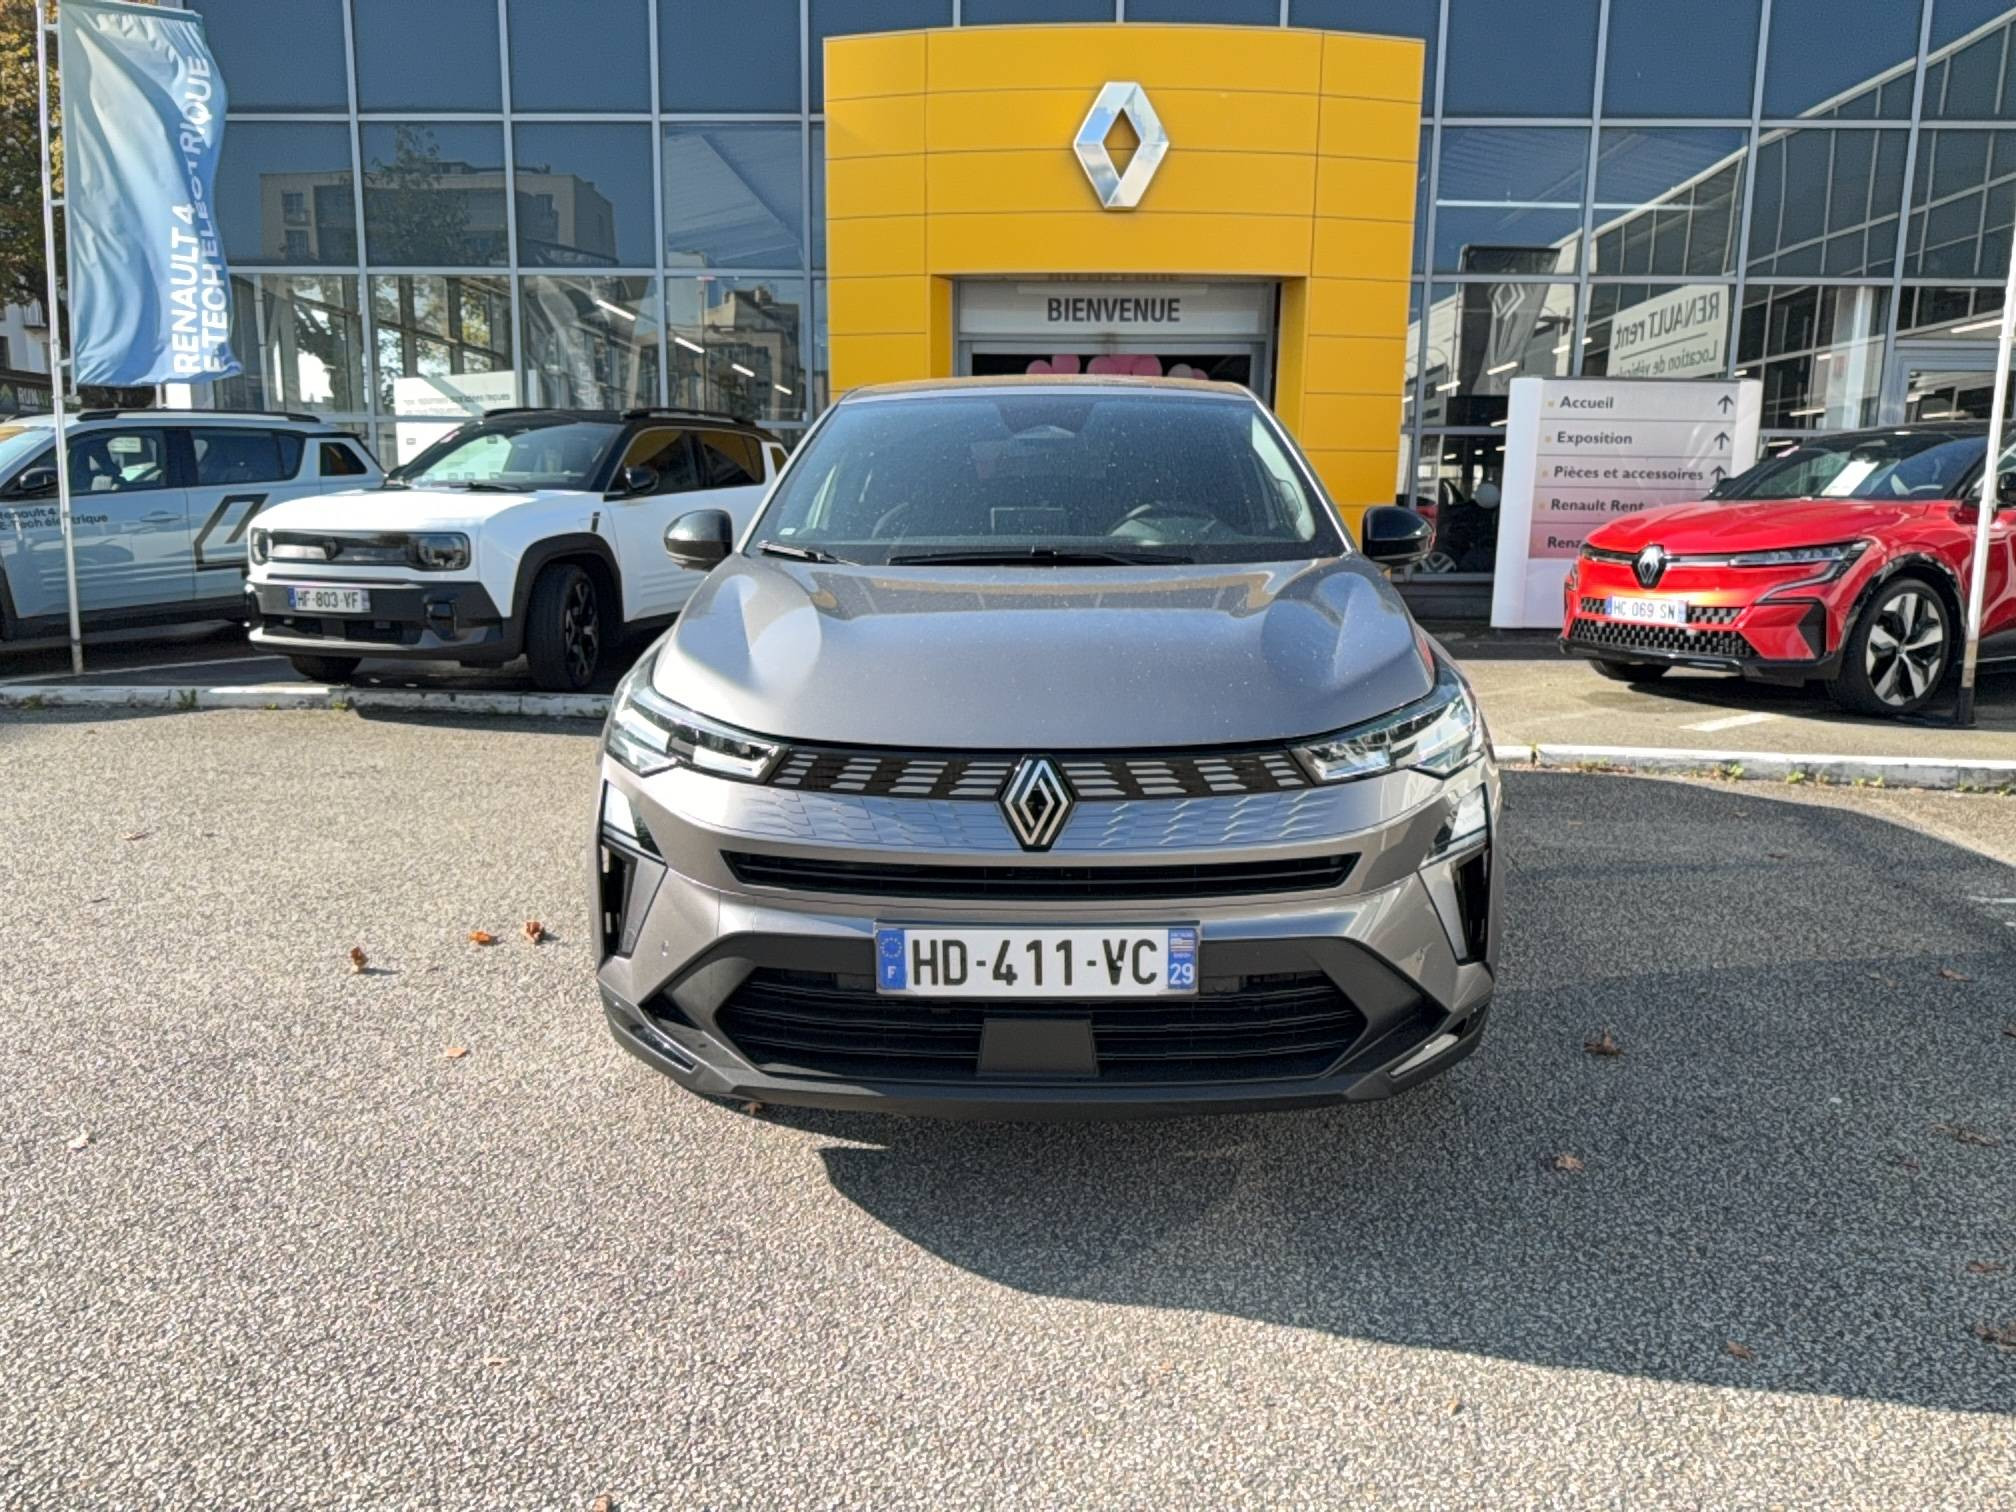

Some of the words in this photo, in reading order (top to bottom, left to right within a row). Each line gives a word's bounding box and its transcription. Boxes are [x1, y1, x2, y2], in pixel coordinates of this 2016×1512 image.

[171, 203, 195, 225] 4
[170, 226, 201, 374] RENAULT
[1047, 298, 1181, 322] BIENVENUE
[1559, 396, 1614, 409] Accueil
[1556, 431, 1633, 447] Exposition
[1553, 465, 1599, 479] Pièces
[1603, 467, 1618, 479] et
[1622, 468, 1704, 481] accessoires
[1551, 498, 1606, 511] Renault
[1610, 499, 1645, 512] Rent
[887, 965, 897, 979] F
[911, 938, 1158, 987] HD-411-VC
[1169, 962, 1194, 985] 29
